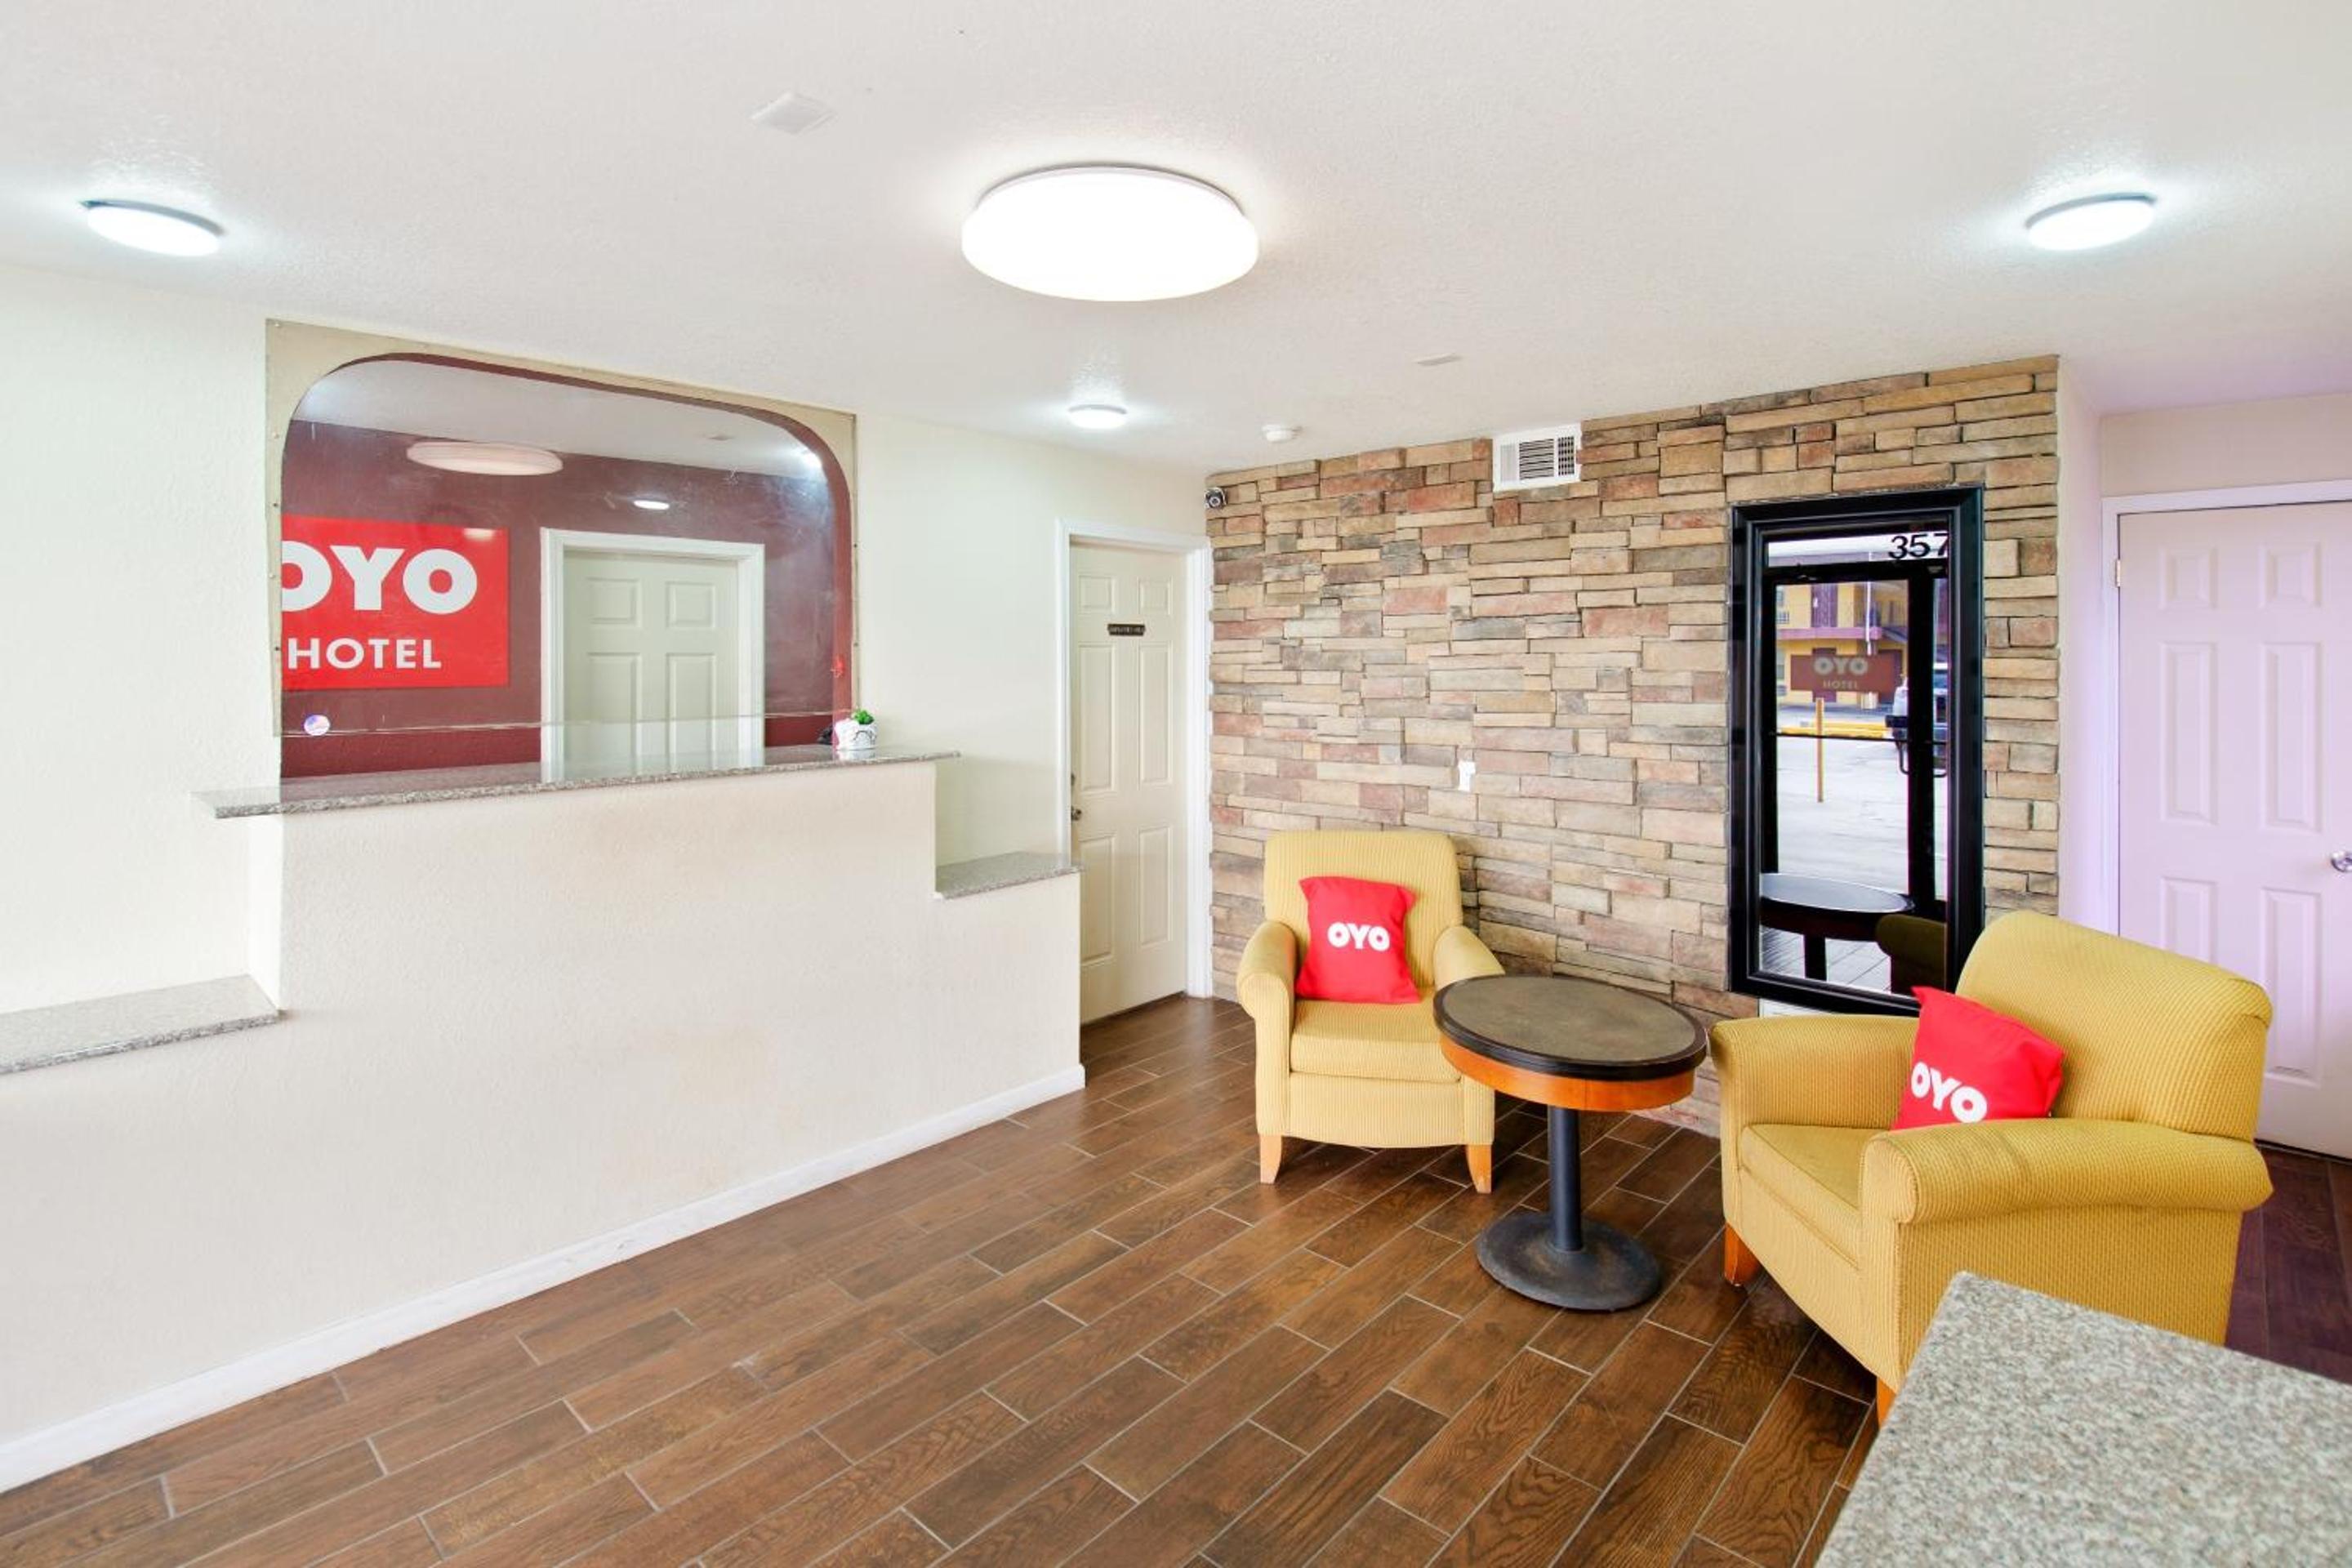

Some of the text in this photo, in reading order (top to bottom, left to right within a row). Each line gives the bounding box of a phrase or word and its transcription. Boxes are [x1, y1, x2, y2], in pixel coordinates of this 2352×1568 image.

[282, 540, 478, 614] OYO
[287, 638, 442, 670] HOTEL
[1813, 657, 1869, 676] OYO
[1327, 921, 1391, 951] OYO
[1911, 1061, 1988, 1124] OYO
